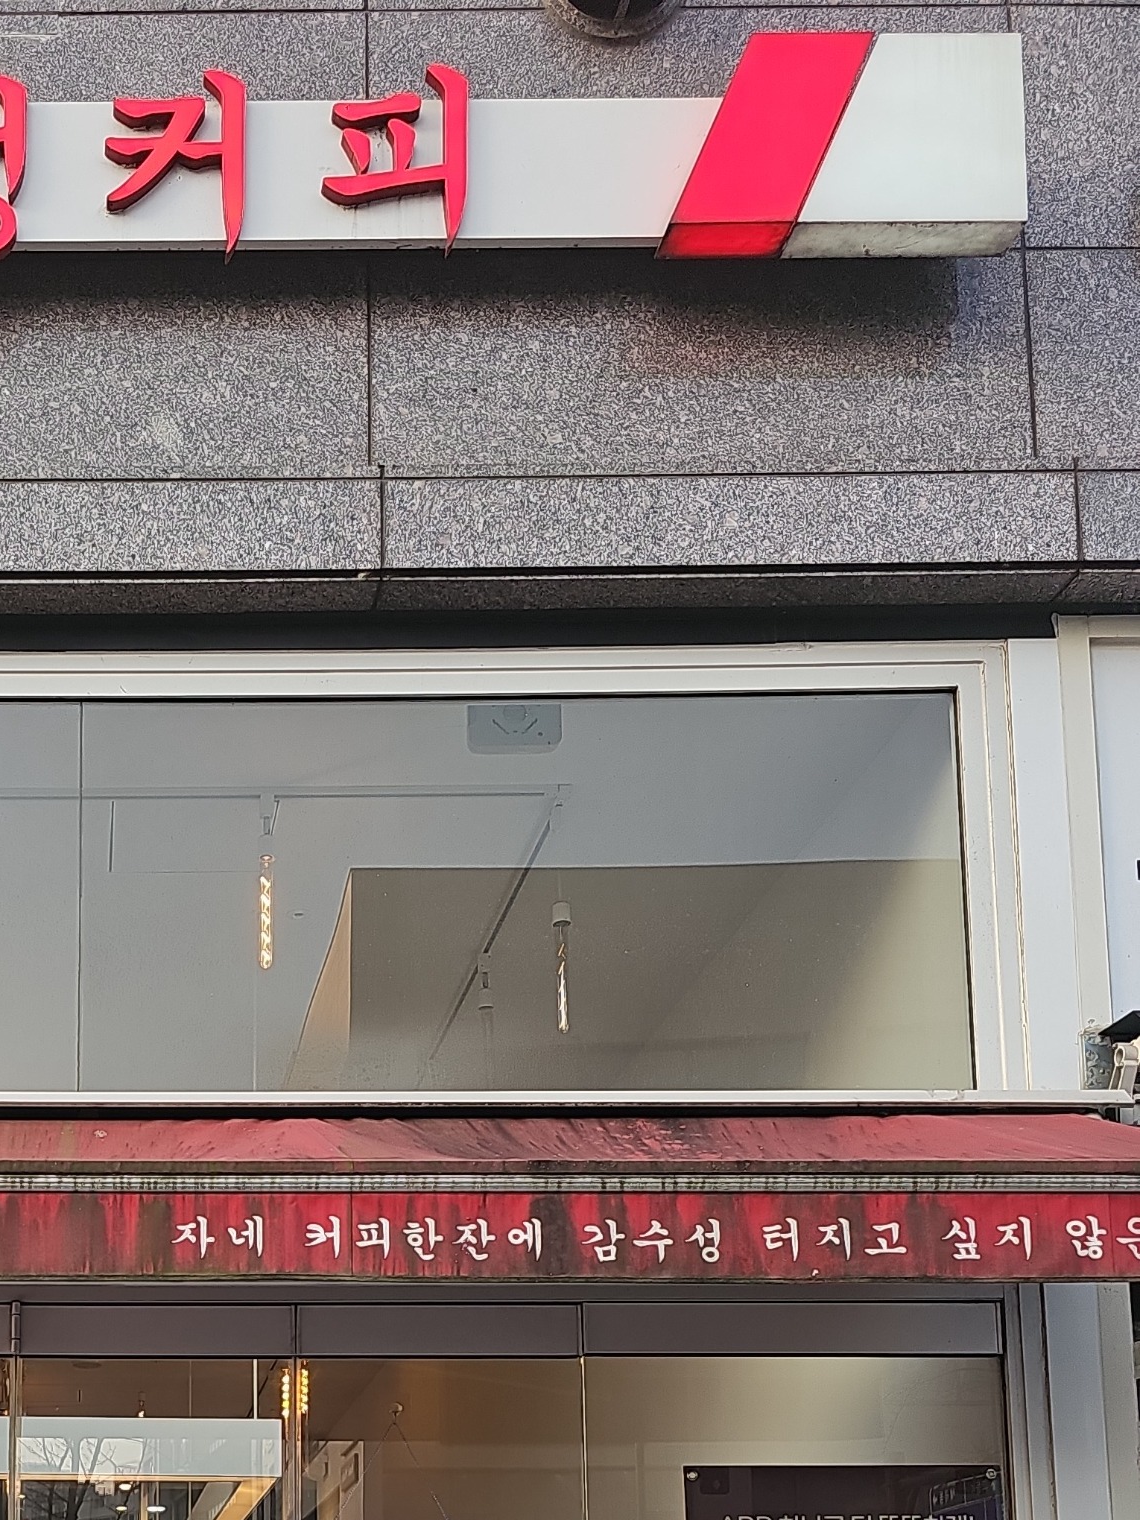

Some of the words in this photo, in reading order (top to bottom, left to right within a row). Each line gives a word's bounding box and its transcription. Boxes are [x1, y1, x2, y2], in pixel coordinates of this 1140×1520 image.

[171, 1214, 265, 1259] 자네
[304, 1214, 544, 1262] 커피한잔에
[582, 1218, 724, 1264] 감수성
[763, 1215, 908, 1262] 터지고
[941, 1215, 1035, 1263] 싶지
